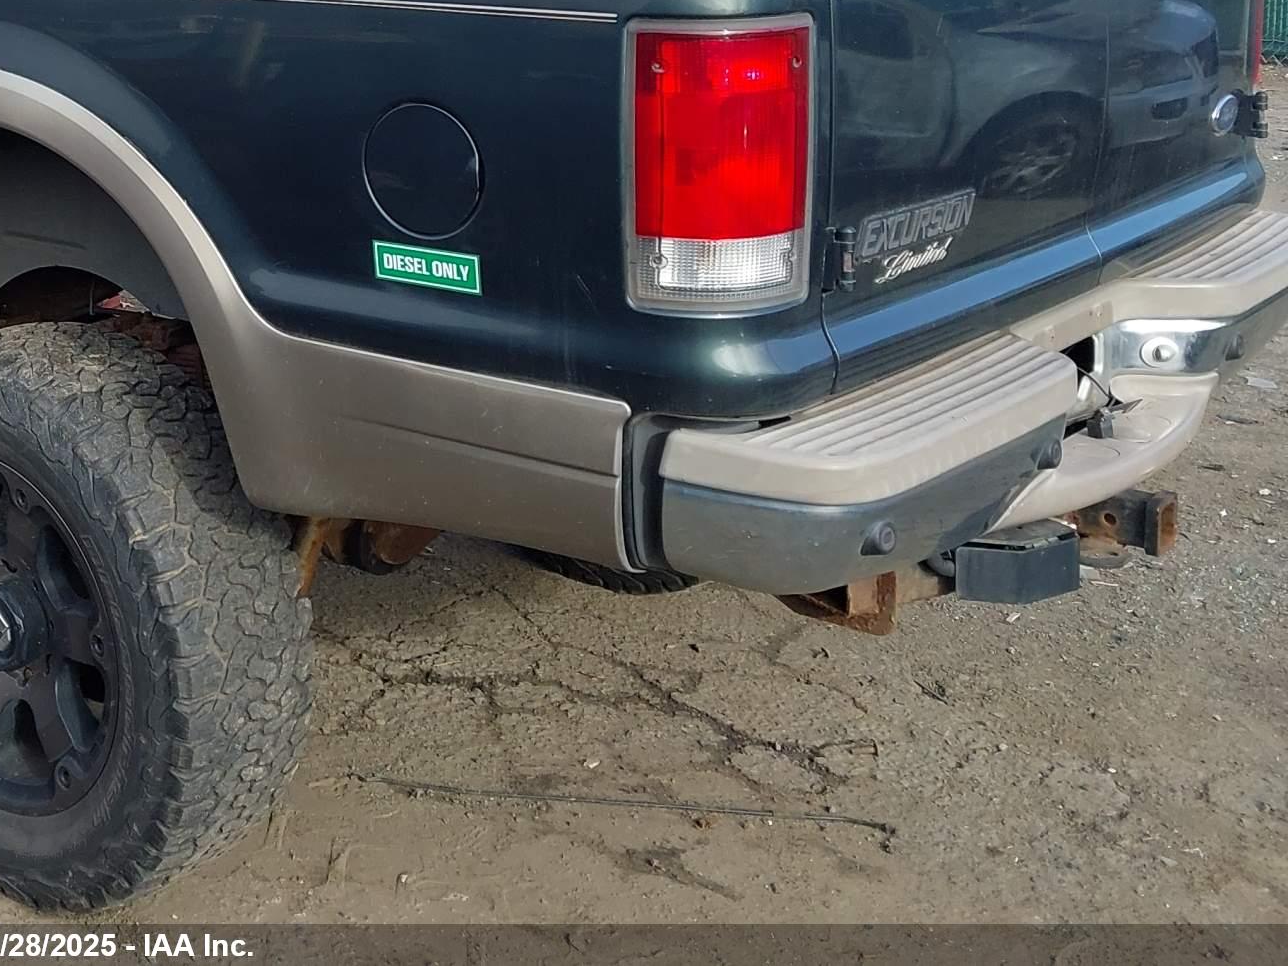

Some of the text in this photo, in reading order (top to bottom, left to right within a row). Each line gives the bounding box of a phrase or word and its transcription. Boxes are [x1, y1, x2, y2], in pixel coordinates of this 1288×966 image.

[860, 192, 976, 257] EXCURSION
[383, 252, 469, 282] DIESEL ONLY
[874, 236, 953, 284] Limited
